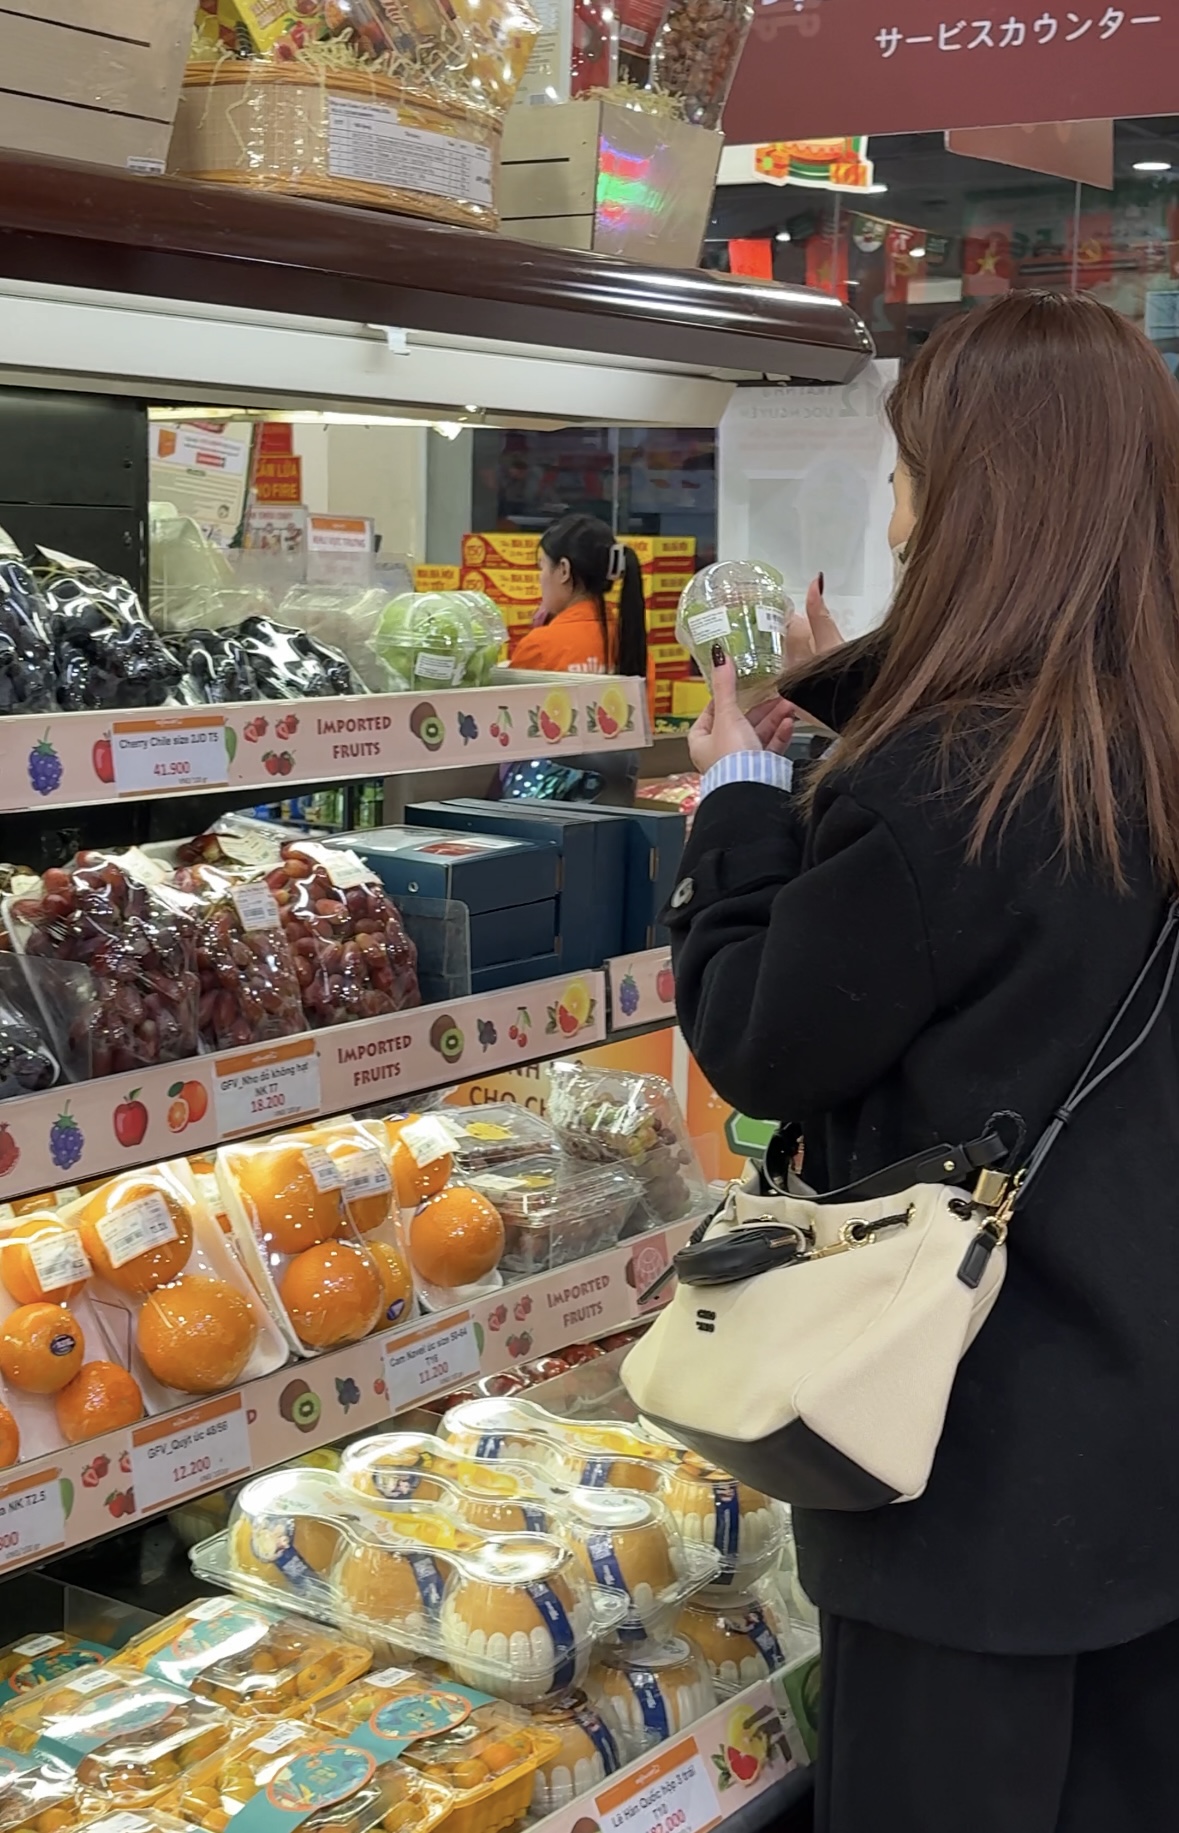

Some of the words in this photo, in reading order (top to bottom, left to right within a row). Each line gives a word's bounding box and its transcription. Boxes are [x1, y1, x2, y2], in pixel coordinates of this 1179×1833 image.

[874, 6, 1162, 58] サービスカウンター
[272, 483, 298, 498] FIRE
[317, 716, 392, 735] IMPORTED
[119, 738, 148, 749] Cherry
[150, 736, 171, 747] Chile
[332, 742, 381, 759] FRUITS
[153, 761, 191, 776] 41.900
[337, 1035, 412, 1064] IMPORTED
[353, 1062, 401, 1087] FRUITS
[546, 1274, 611, 1308] IMPORTED
[563, 1300, 604, 1328] FRUITS
[172, 1456, 211, 1482] 12.200
